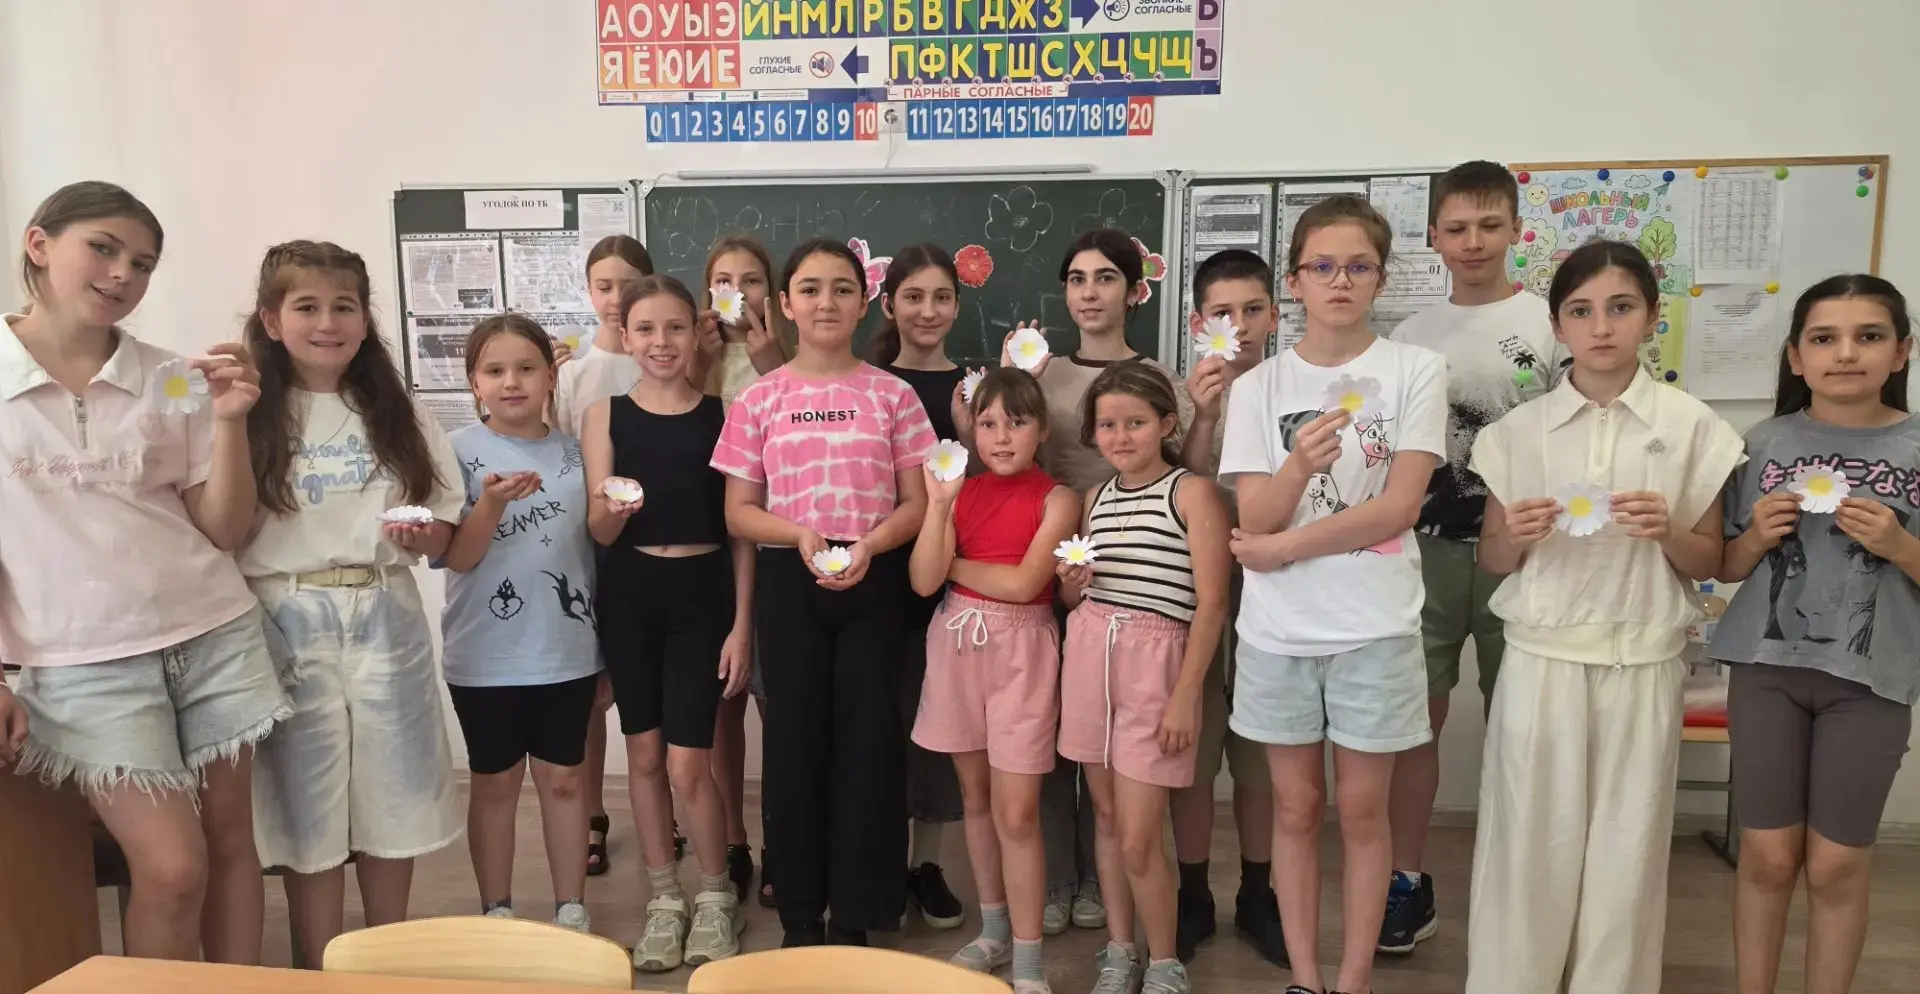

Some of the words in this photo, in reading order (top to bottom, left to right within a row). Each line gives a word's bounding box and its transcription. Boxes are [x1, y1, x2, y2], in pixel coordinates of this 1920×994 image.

[602, 4, 624, 38] А
[628, 3, 653, 38] О
[658, 3, 680, 38] У
[684, 2, 710, 37] Ы
[715, 1, 736, 37] Э
[1134, 4, 1193, 15] СОГЛАСНЫЕ
[603, 50, 624, 84] Я
[633, 45, 652, 84] Ё
[658, 48, 683, 84] Ю
[685, 49, 711, 84] И
[718, 48, 736, 83] Е
[758, 56, 792, 64] ГЛУХИЕ
[891, 44, 915, 80] П
[919, 42, 946, 79] Ф
[951, 43, 975, 79] К
[982, 43, 1003, 78] Т
[1008, 42, 1036, 78] Ш
[1041, 40, 1064, 77] С
[1071, 40, 1096, 76] Х
[1101, 38, 1127, 75] Ц
[1133, 37, 1157, 74] Ч
[1161, 36, 1191, 75] Щ
[749, 65, 802, 75] СОГЛАСНЫЕ
[903, 87, 961, 98] ПАРНЫЕ
[968, 85, 1053, 97] СОГЛАСНЫЕ
[650, 111, 663, 136] 0
[671, 111, 681, 136] 1
[690, 110, 703, 136] 2
[711, 110, 723, 136] 3
[732, 110, 746, 136] 4
[753, 109, 765, 136] 5
[774, 109, 786, 135] 6
[795, 109, 807, 135] 7
[816, 109, 829, 135] 8
[837, 108, 850, 135] 9
[857, 108, 876, 135] 10
[909, 108, 928, 134] 11
[933, 107, 953, 134] 12
[958, 107, 978, 133] 13
[982, 106, 1004, 133] 14
[1007, 106, 1027, 132] 15
[1031, 105, 1053, 132] 16
[1056, 104, 1077, 131] 17
[1080, 104, 1102, 131] 18
[1105, 103, 1127, 130] 19
[1128, 103, 1152, 130] 20
[481, 200, 519, 208] УГОЛОК
[521, 199, 535, 208] ПО
[536, 199, 548, 208] ТБ
[1549, 190, 1650, 214] ШКОЛЬНЫЙ
[1562, 207, 1639, 230] ЛАГЕРЬ
[791, 410, 857, 424] HONEST
[493, 500, 566, 541] EAMER
